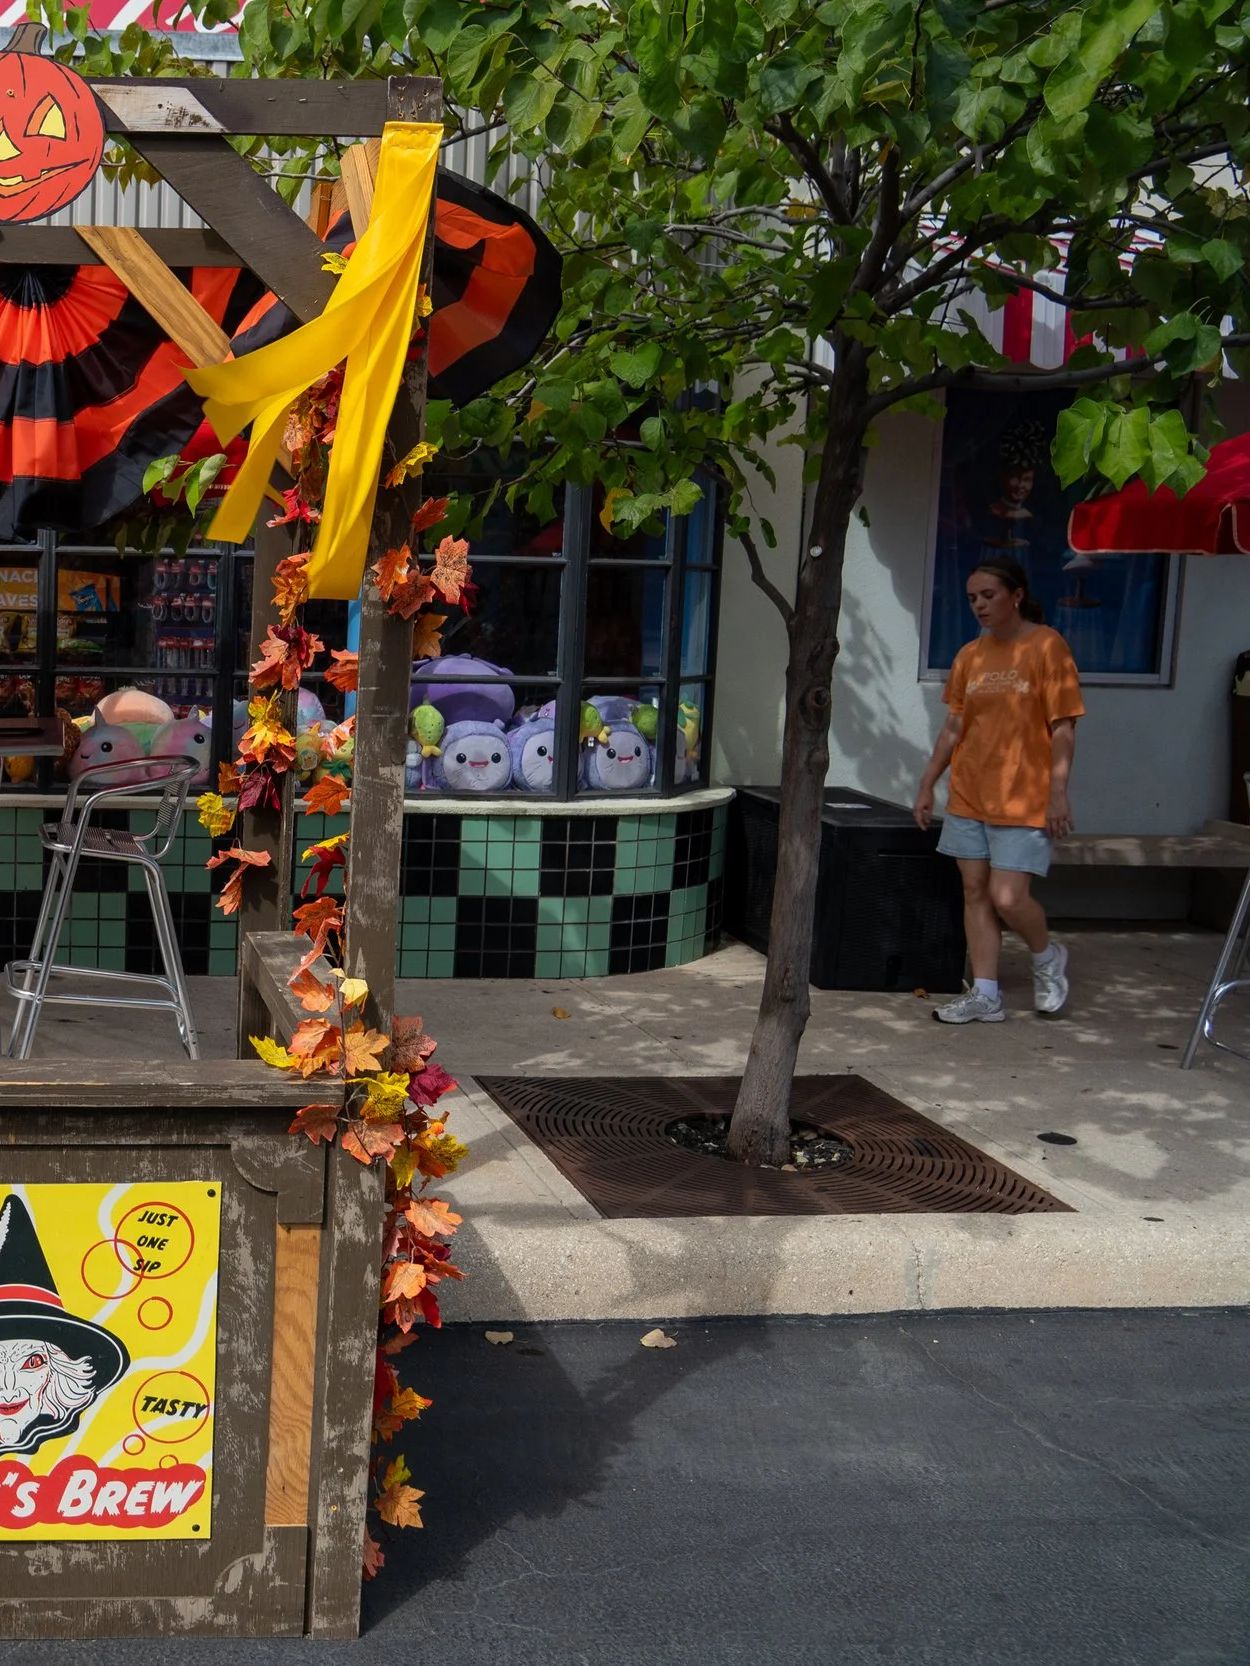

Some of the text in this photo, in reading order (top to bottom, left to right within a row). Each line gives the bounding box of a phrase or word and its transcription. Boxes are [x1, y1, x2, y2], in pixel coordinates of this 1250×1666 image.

[137, 1210, 179, 1228] JUST
[136, 1234, 169, 1251] ONE
[132, 1258, 162, 1273] SIP
[140, 1395, 209, 1420] TASTY
[57, 1468, 206, 1518] BREW
